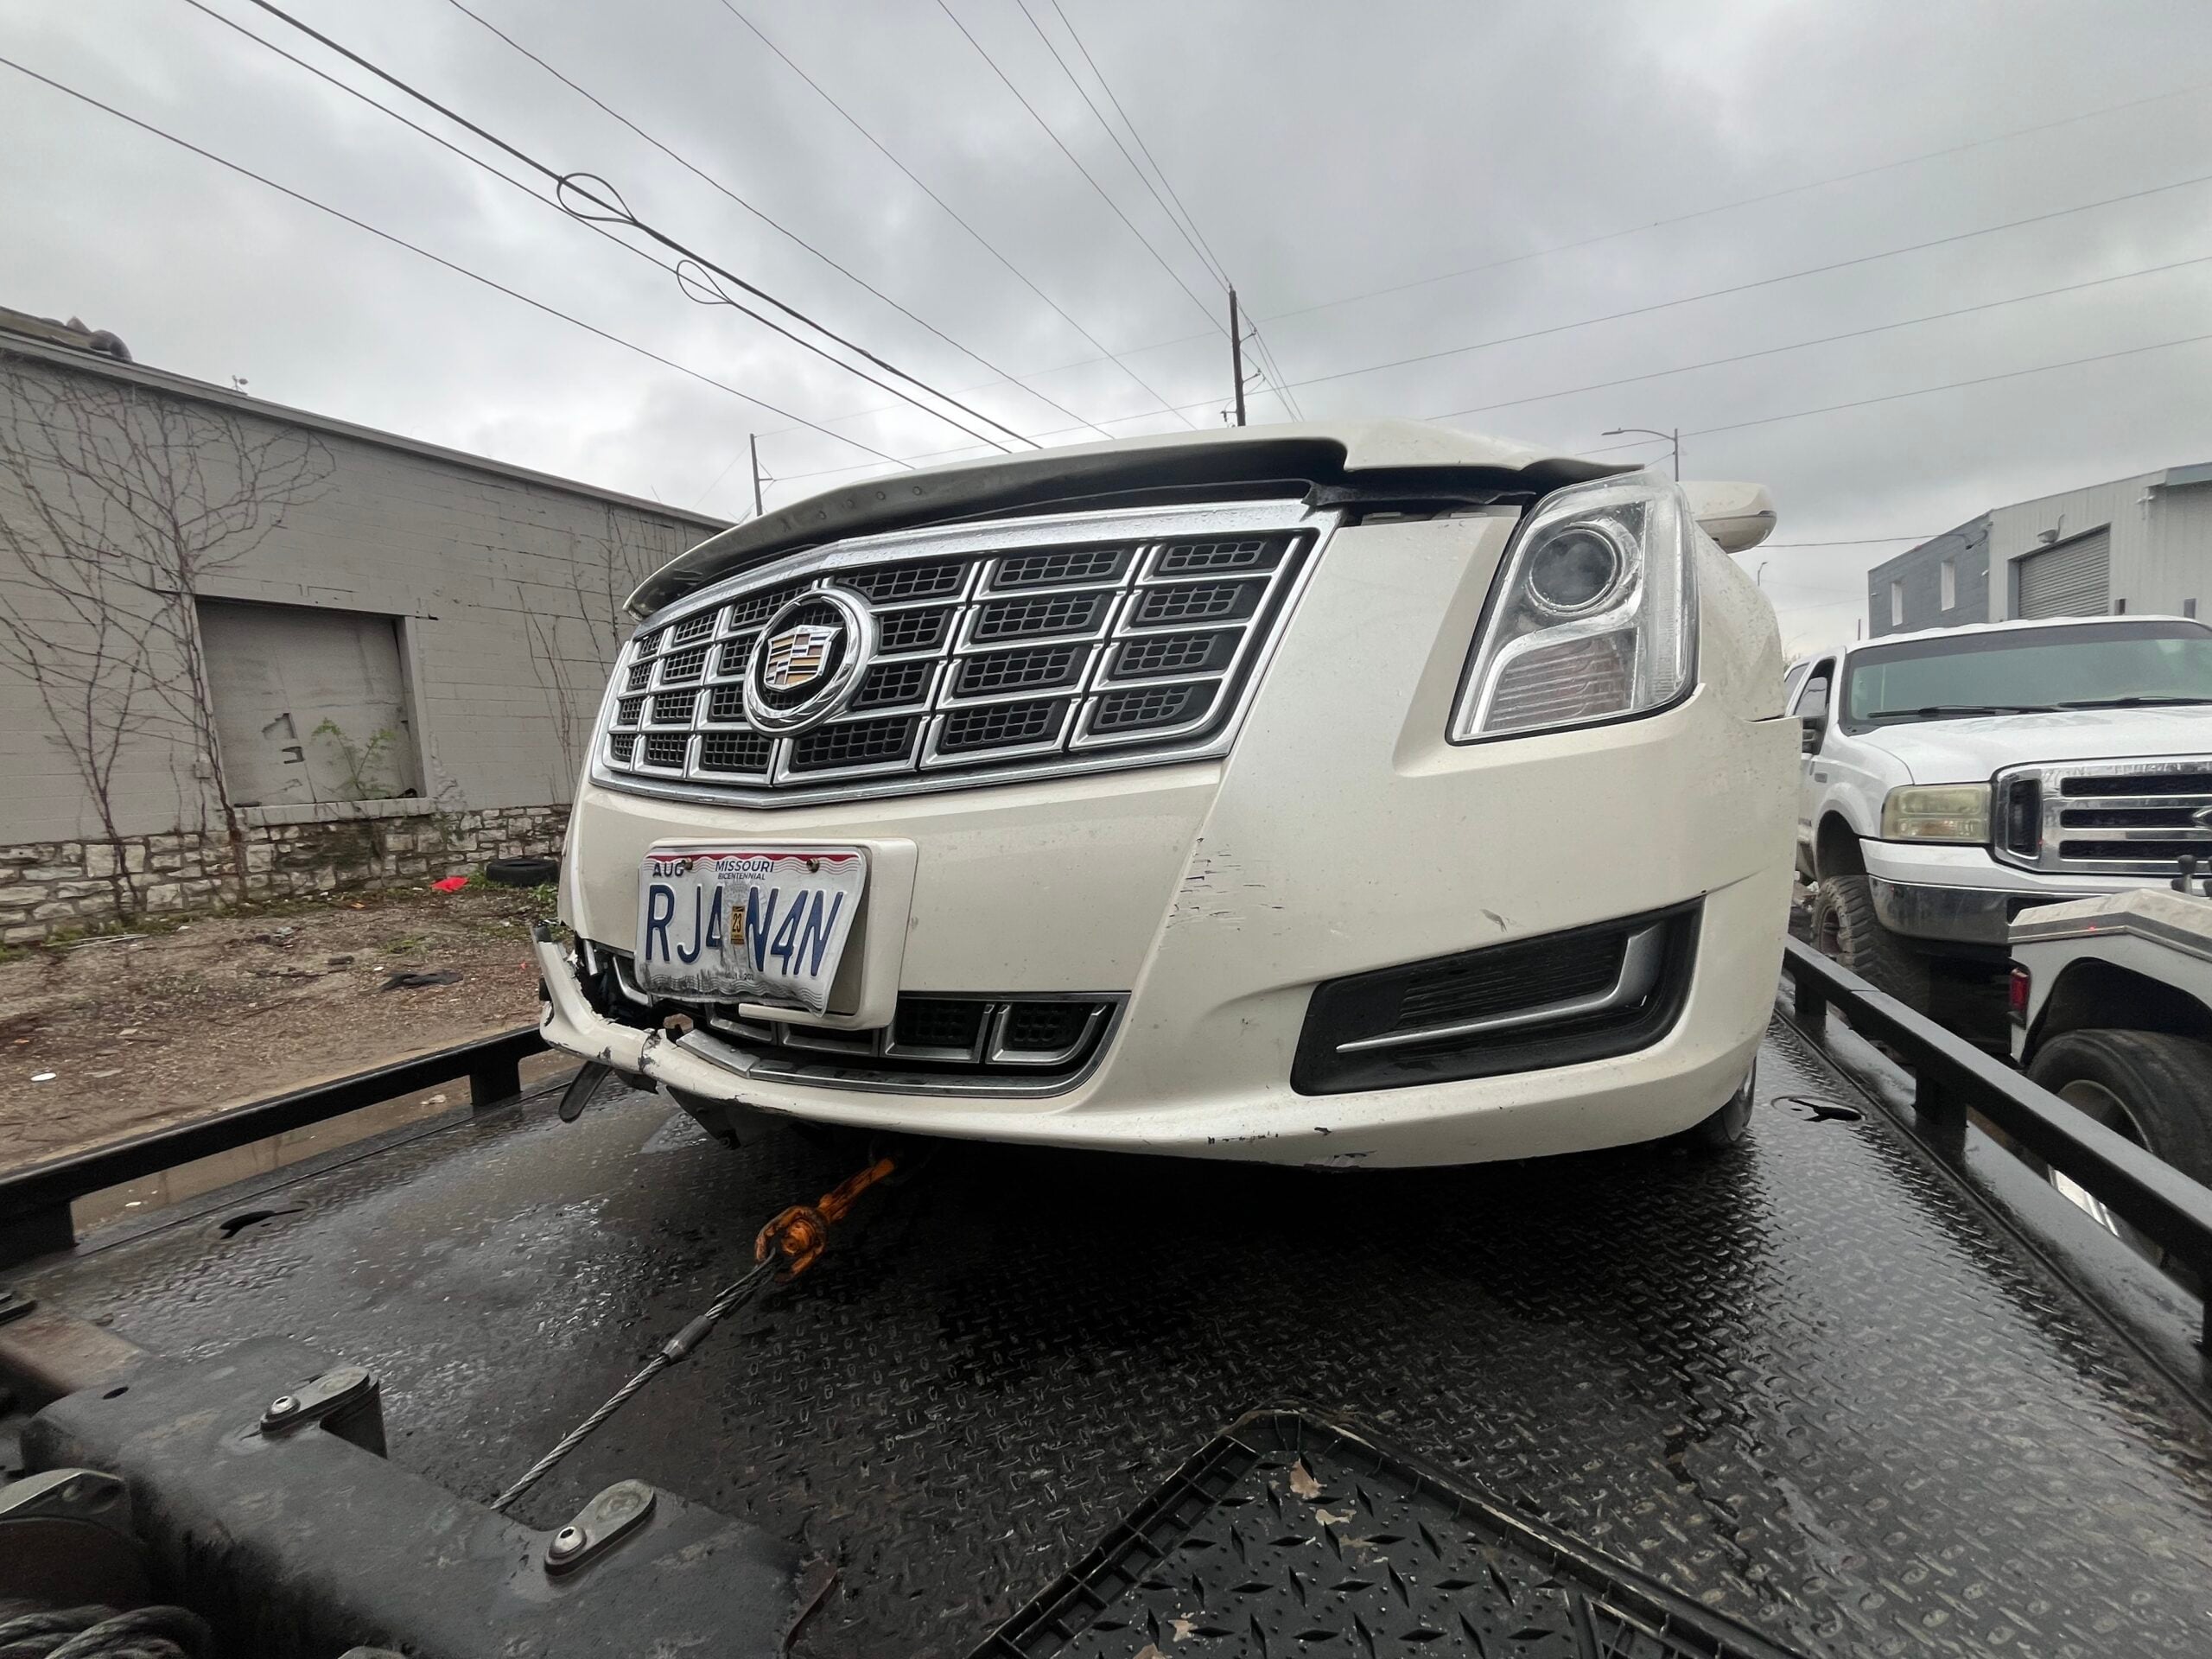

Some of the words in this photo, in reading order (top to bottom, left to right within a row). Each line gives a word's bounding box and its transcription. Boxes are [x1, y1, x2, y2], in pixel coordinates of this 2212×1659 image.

[652, 860, 684, 878] AUG
[715, 861, 774, 873] MISSOURI
[717, 872, 766, 880] BICENTENNIAL
[732, 912, 742, 933] 23
